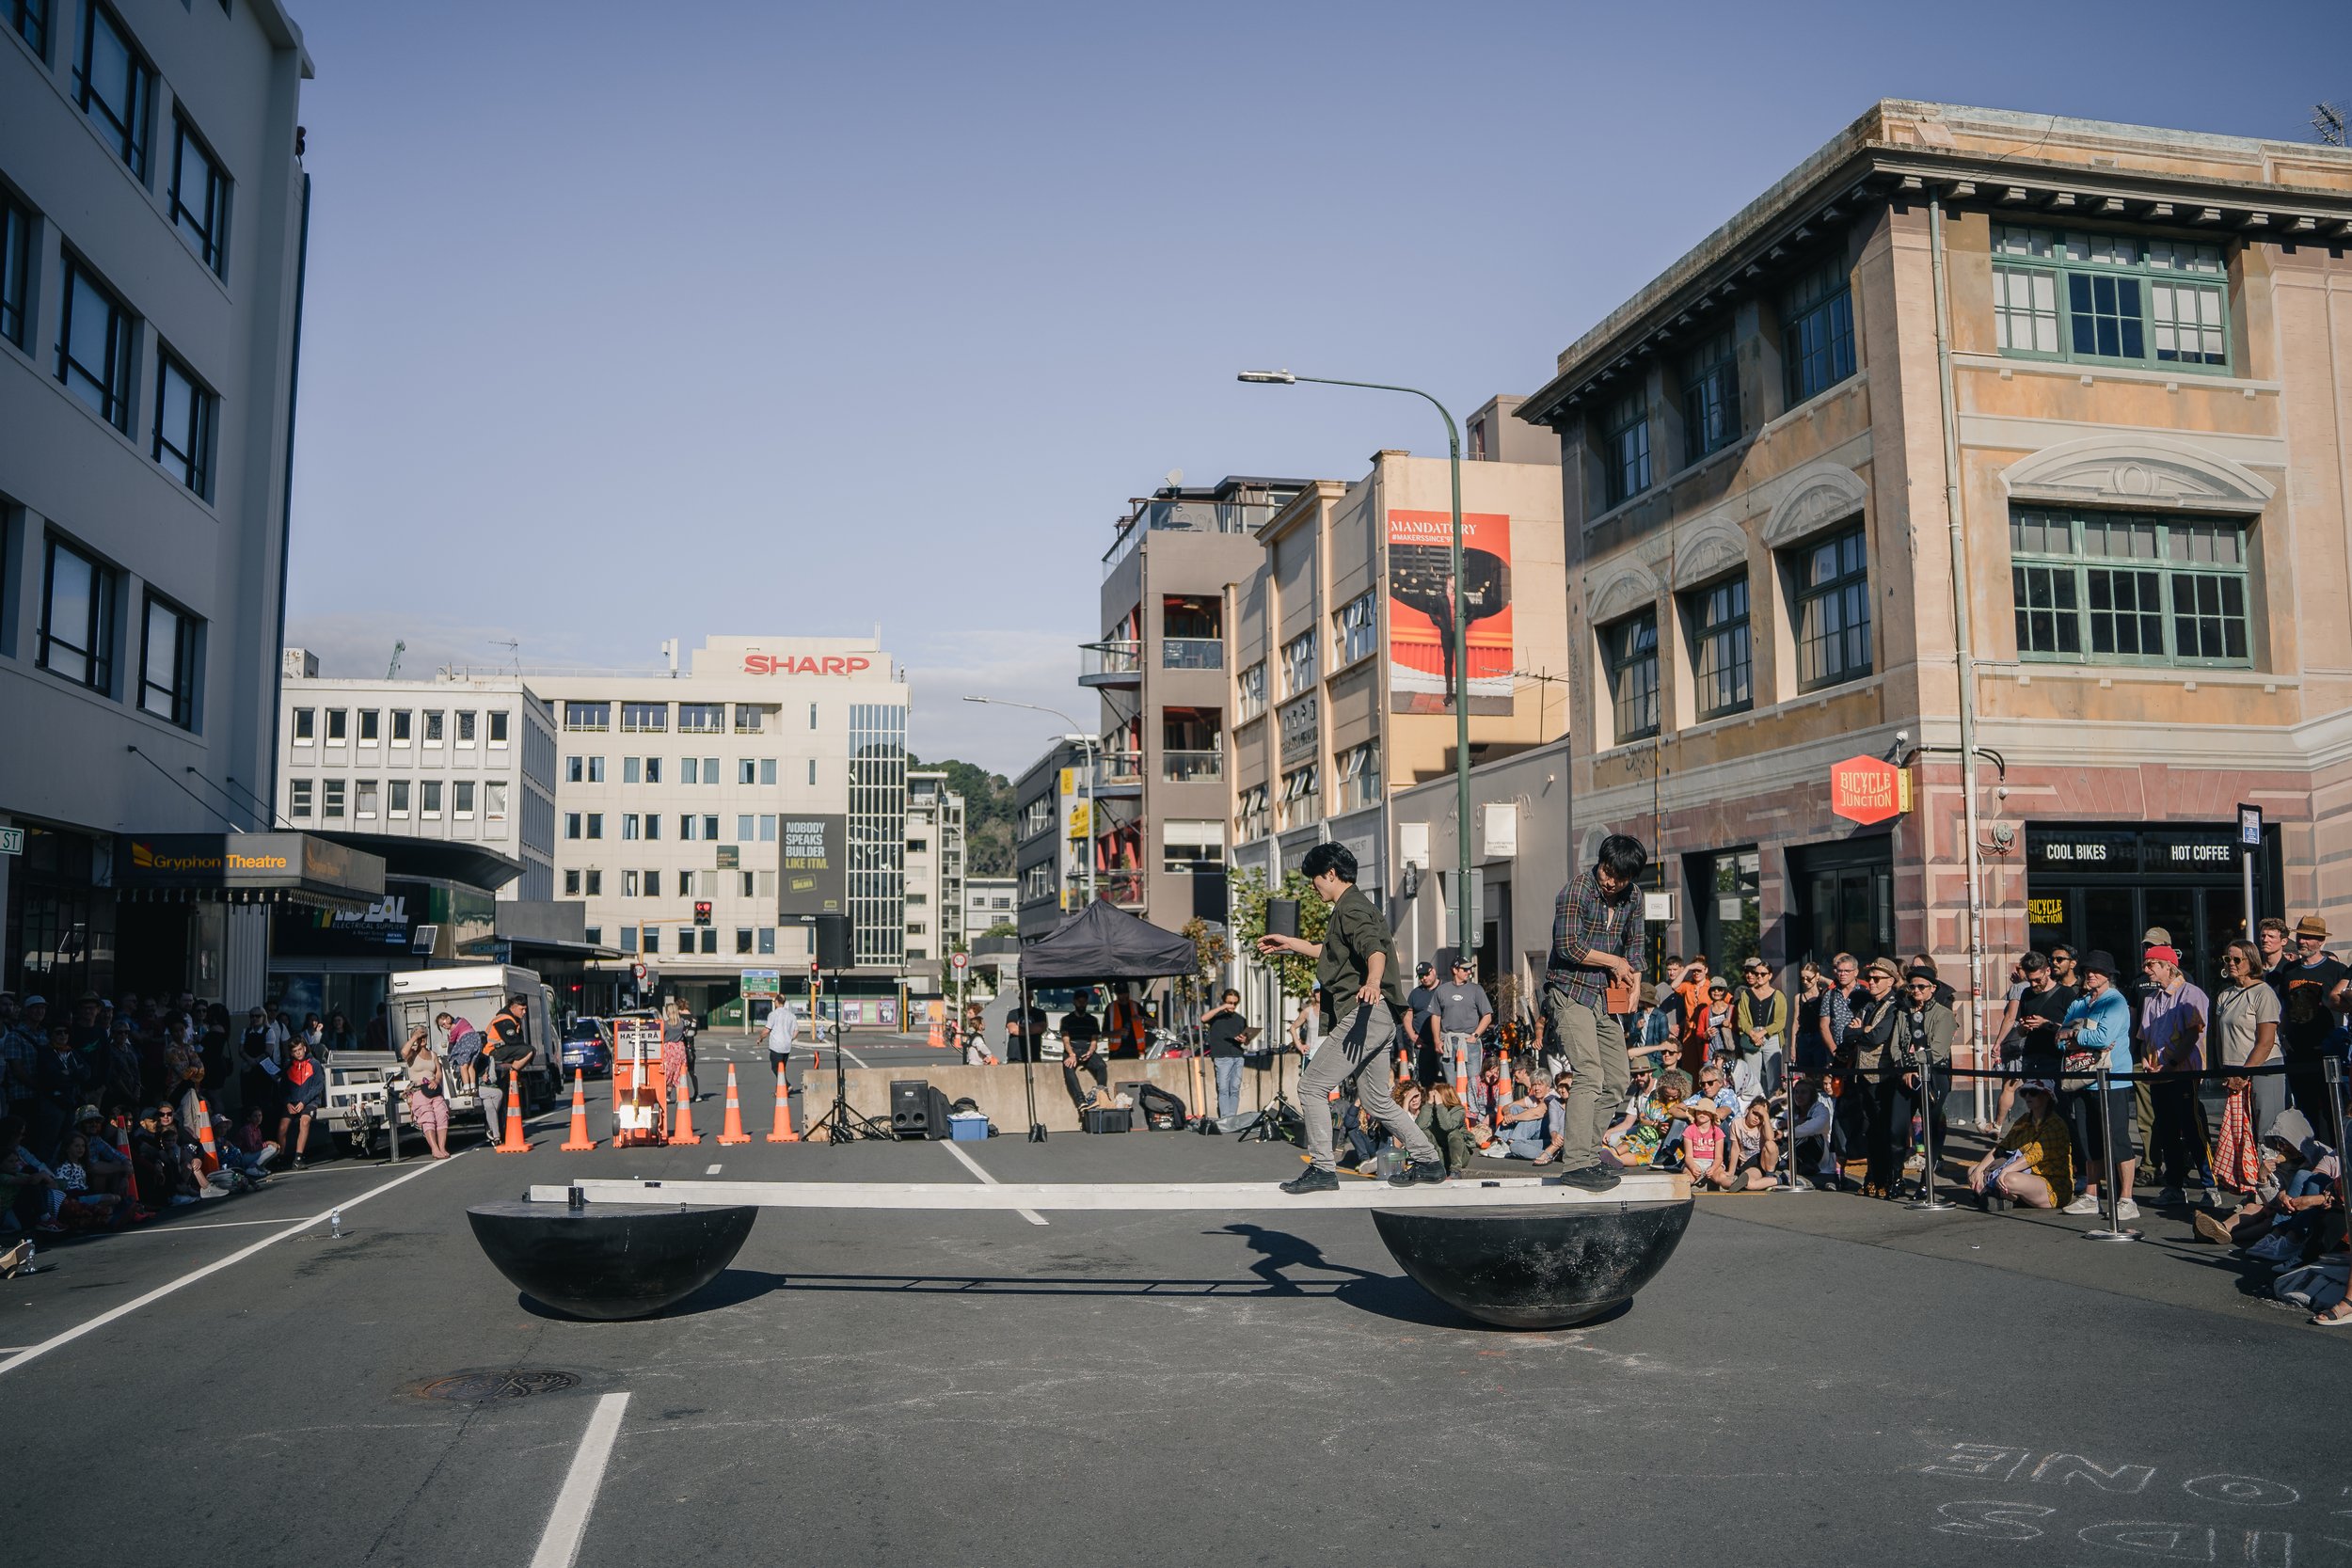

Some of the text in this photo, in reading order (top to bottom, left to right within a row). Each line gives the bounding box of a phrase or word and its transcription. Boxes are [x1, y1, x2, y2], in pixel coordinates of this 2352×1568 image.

[744, 655, 870, 675] SHARP
[1840, 771, 1891, 795] BICYCLE
[1840, 789, 1892, 807] JUNCTION
[786, 821, 825, 833] NOBODY
[3, 832, 18, 849] ST
[786, 833, 823, 846] SPEAKS
[786, 846, 825, 858] BUILDER
[2046, 844, 2106, 861] COOL BIKES
[2171, 845, 2230, 861] HOT COFFEE
[153, 853, 286, 871] Gryphon Theatre
[786, 857, 829, 869] LIKE ITM.
[2028, 898, 2062, 916] BICYCLE
[332, 921, 374, 929] ELECTRICAL
[2028, 911, 2063, 924] JUNCTION
[1920, 1442, 2352, 1517] ONE
